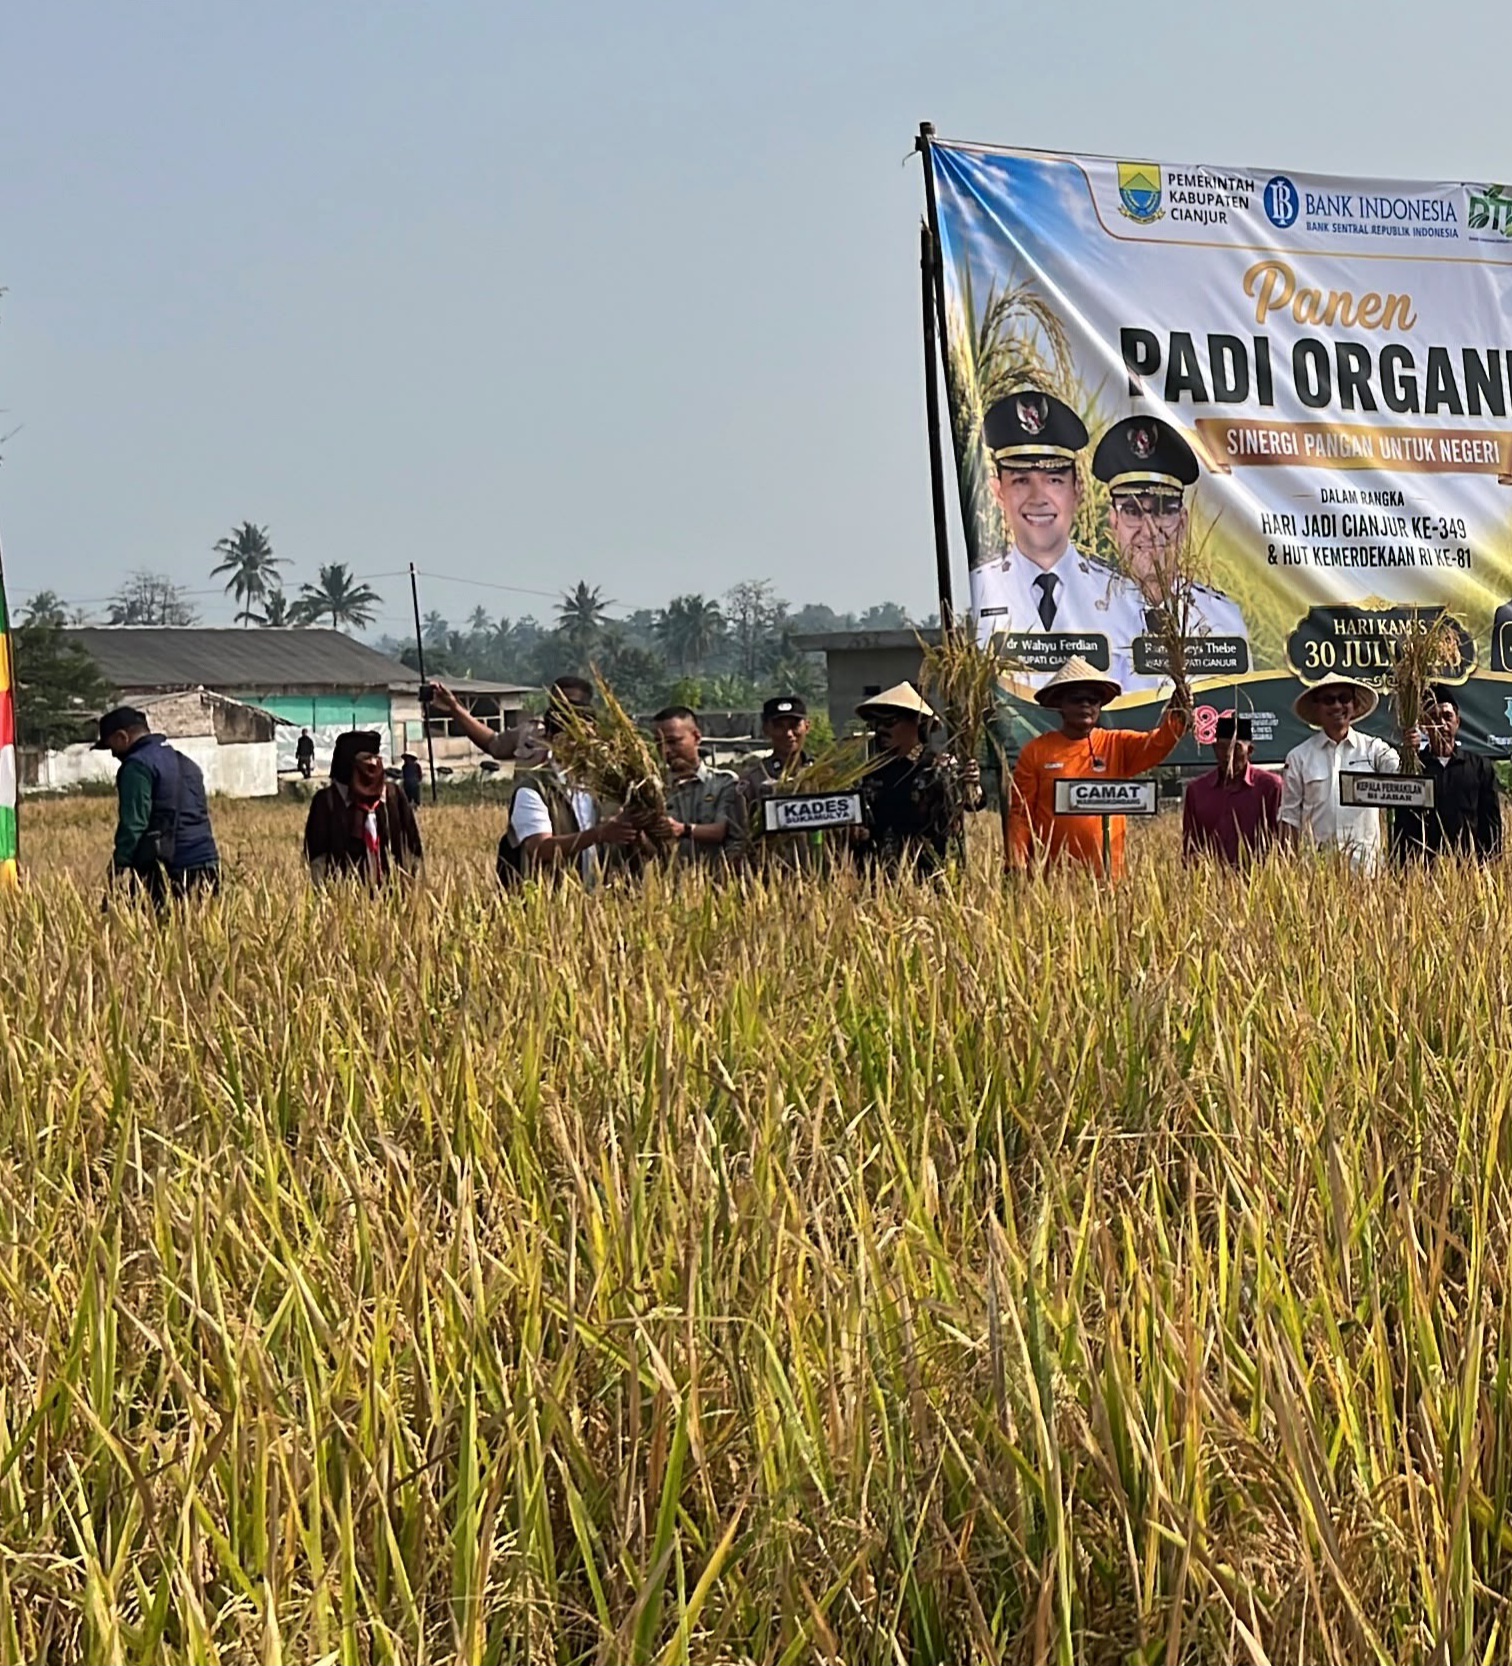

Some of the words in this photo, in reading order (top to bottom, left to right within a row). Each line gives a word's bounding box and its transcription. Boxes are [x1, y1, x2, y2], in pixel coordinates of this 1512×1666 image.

[1168, 173, 1255, 192] PEMERINTAH
[1169, 191, 1250, 209] KABUPATEN
[1305, 193, 1354, 218] BANK
[1359, 197, 1458, 222] INDONESIA
[1171, 208, 1228, 226] CIANJUR
[1306, 221, 1330, 232] BANK
[1332, 222, 1368, 235] SENTRAL
[1371, 224, 1410, 237] REPUBLIK
[1413, 226, 1459, 238] INDONESIA
[1242, 260, 1417, 331] Panen
[1119, 327, 1274, 407] PADI
[1227, 428, 1299, 456] SINERGI
[1304, 433, 1374, 459] PANGAN
[1379, 436, 1436, 462] UNTUK
[1440, 438, 1500, 465] NEGERI
[1320, 488, 1358, 504] DALAM
[1360, 491, 1405, 507] RANGKA
[1261, 513, 1297, 537] HARI
[1302, 514, 1337, 538] JADI
[1342, 514, 1409, 539] CIANJUR
[1411, 516, 1467, 540] KE-349
[1267, 544, 1278, 566] &
[1283, 544, 1309, 566] HUT
[1313, 545, 1415, 568] KEMERDEKAAN
[1418, 547, 1433, 567] RI
[1435, 548, 1472, 569] KE-81
[1333, 618, 1374, 636] HARI
[1378, 619, 1428, 636] KAMS
[1006, 638, 1018, 650] dr
[1022, 639, 1057, 653] Wahyu
[1060, 640, 1098, 651] Ferdian
[1206, 642, 1236, 654] Thebe
[1304, 641, 1336, 668] 30
[1076, 786, 1141, 798] CAMAT
[1356, 781, 1380, 792] KEPALA
[784, 799, 849, 817] KADES
